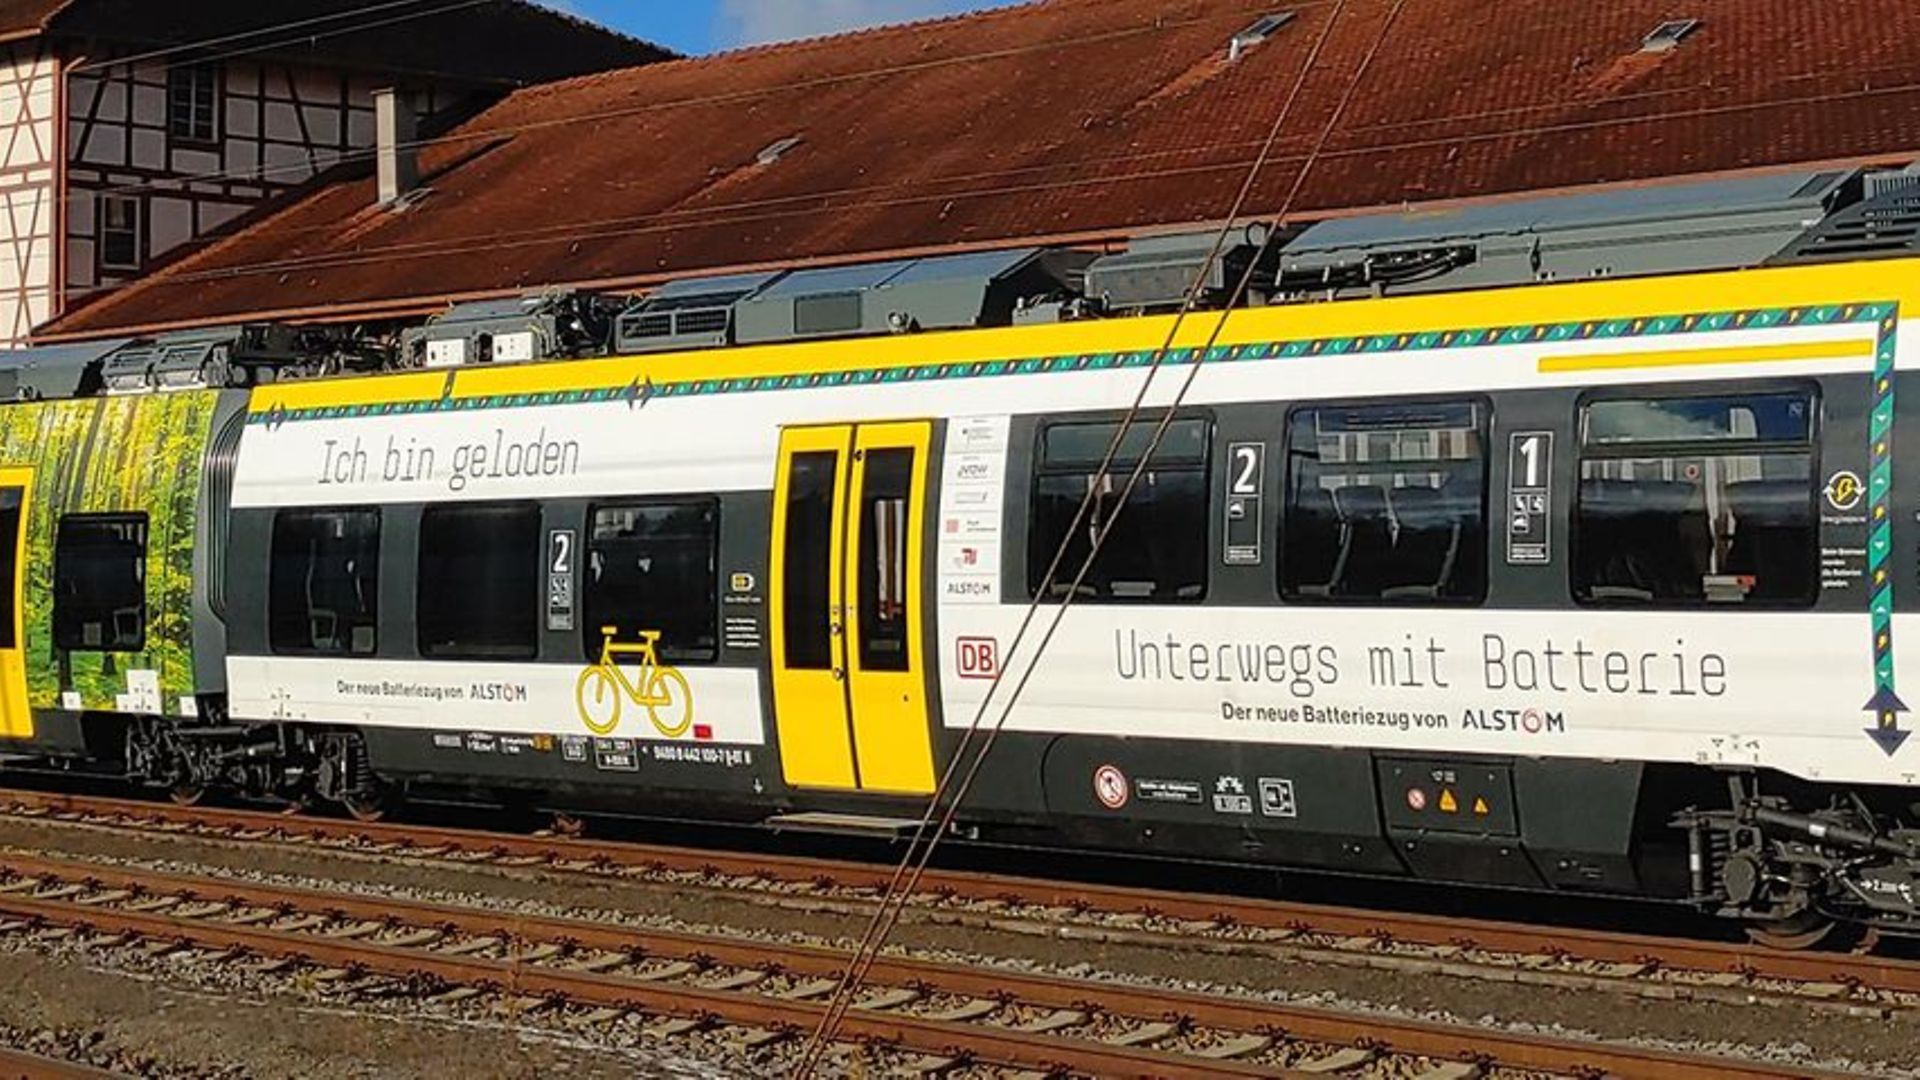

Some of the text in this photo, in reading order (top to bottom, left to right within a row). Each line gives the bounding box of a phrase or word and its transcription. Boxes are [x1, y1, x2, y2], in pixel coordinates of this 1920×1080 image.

[318, 427, 580, 491] Ich bin geladen
[1233, 446, 1256, 493] 2
[1520, 437, 1538, 486] 1
[553, 534, 569, 572] 2
[960, 643, 994, 674] DB
[1115, 628, 1727, 698] Unterwegs mit Batterie
[336, 679, 355, 694] Der
[356, 682, 380, 696] neue
[444, 685, 464, 699] von
[469, 683, 527, 702] ALSTOM
[1221, 702, 1565, 734] Der neue Batteriezug von ALSTOM
